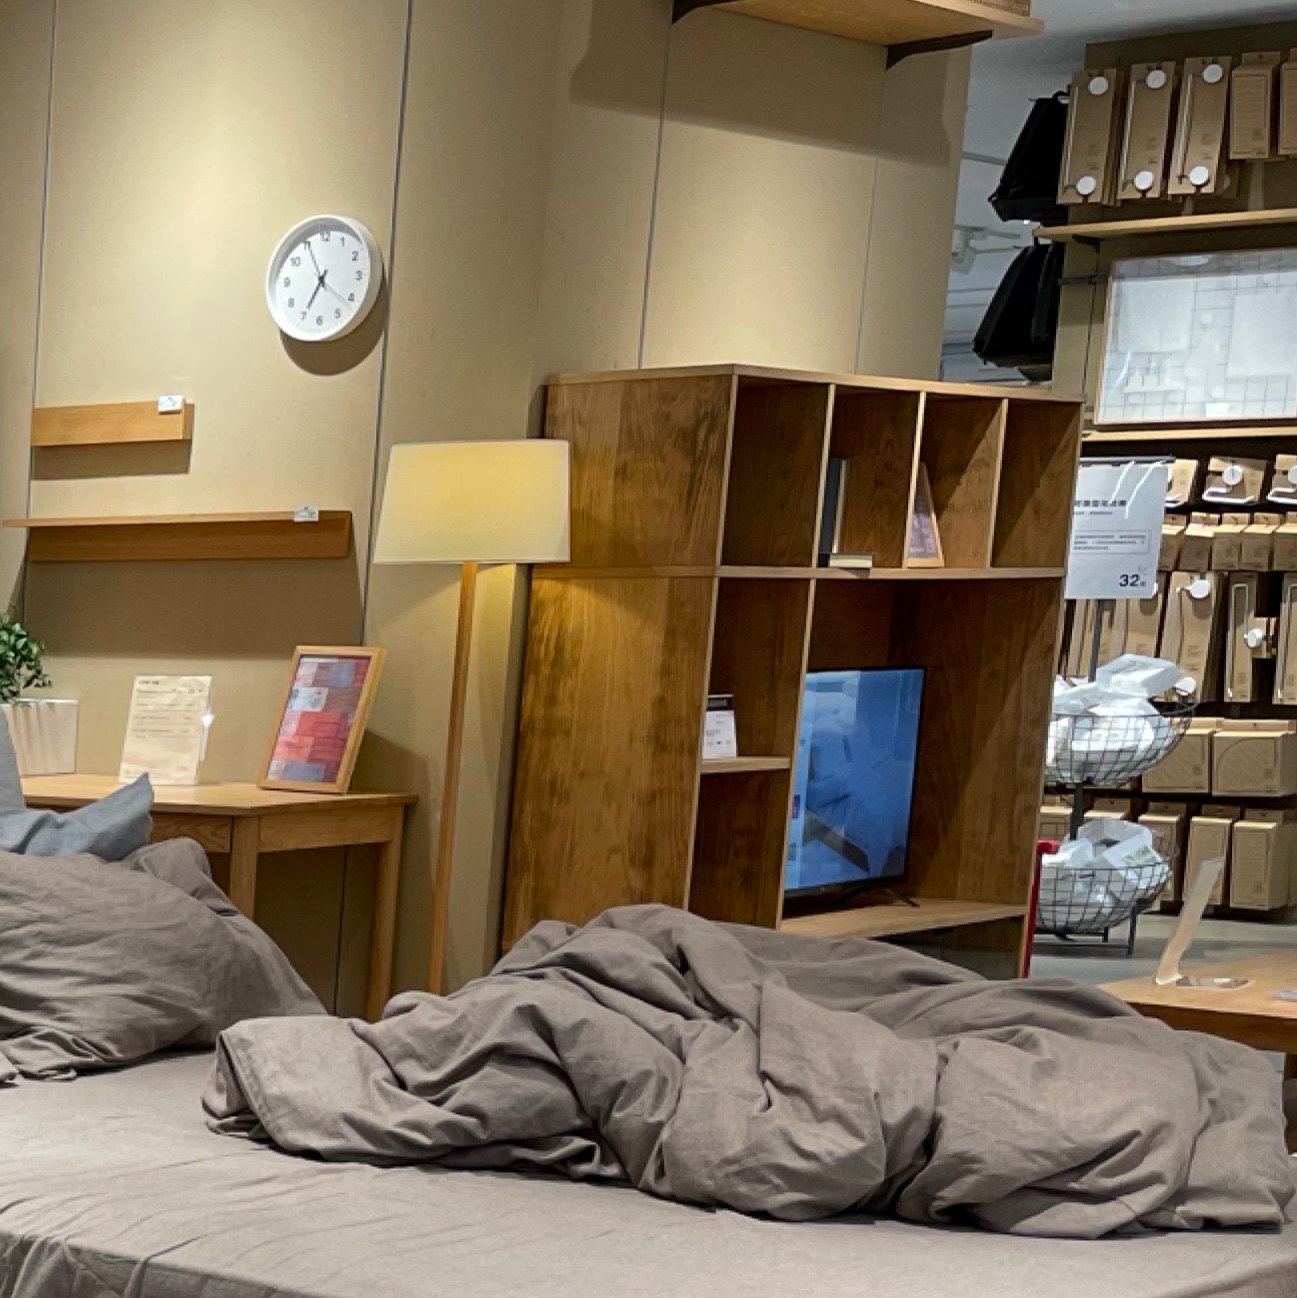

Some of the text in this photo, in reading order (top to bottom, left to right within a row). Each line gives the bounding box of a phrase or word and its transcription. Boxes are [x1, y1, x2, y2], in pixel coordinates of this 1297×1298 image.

[352, 251, 359, 261] 2
[300, 311, 307, 321] 7
[334, 308, 341, 319] 5
